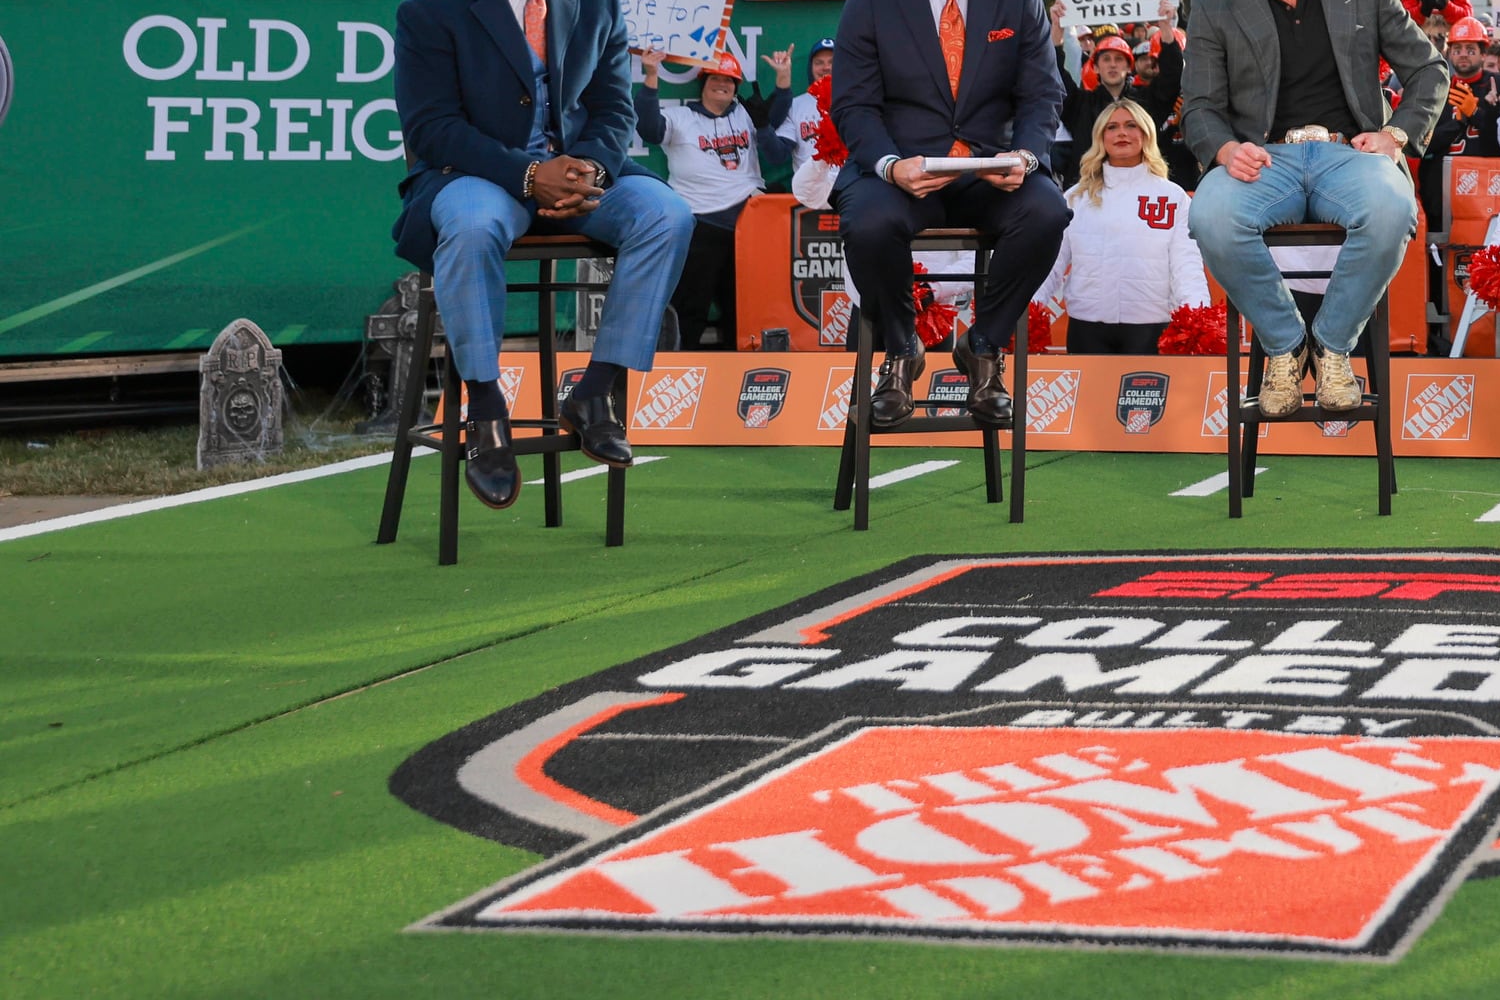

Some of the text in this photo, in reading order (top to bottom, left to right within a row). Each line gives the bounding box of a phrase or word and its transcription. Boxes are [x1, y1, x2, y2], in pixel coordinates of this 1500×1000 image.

[123, 14, 311, 83] OLD
[145, 96, 408, 162] FREIG
[634, 367, 704, 428] HOME
[647, 374, 674, 397] THE
[740, 392, 784, 401] GAMEDAY
[928, 393, 969, 401] GAMEDA
[1118, 397, 1165, 406] GAMEDAY
[1413, 382, 1440, 407] THE
[656, 390, 699, 429] DEPOT
[1034, 395, 1074, 433] DEPOT
[1404, 375, 1473, 438] HOME
[1428, 400, 1471, 439] DEPOT
[1010, 708, 1418, 736] BUILT BY
[810, 744, 1152, 815] THE
[595, 738, 1493, 917] HOME
[876, 801, 1450, 922] DEPOT
